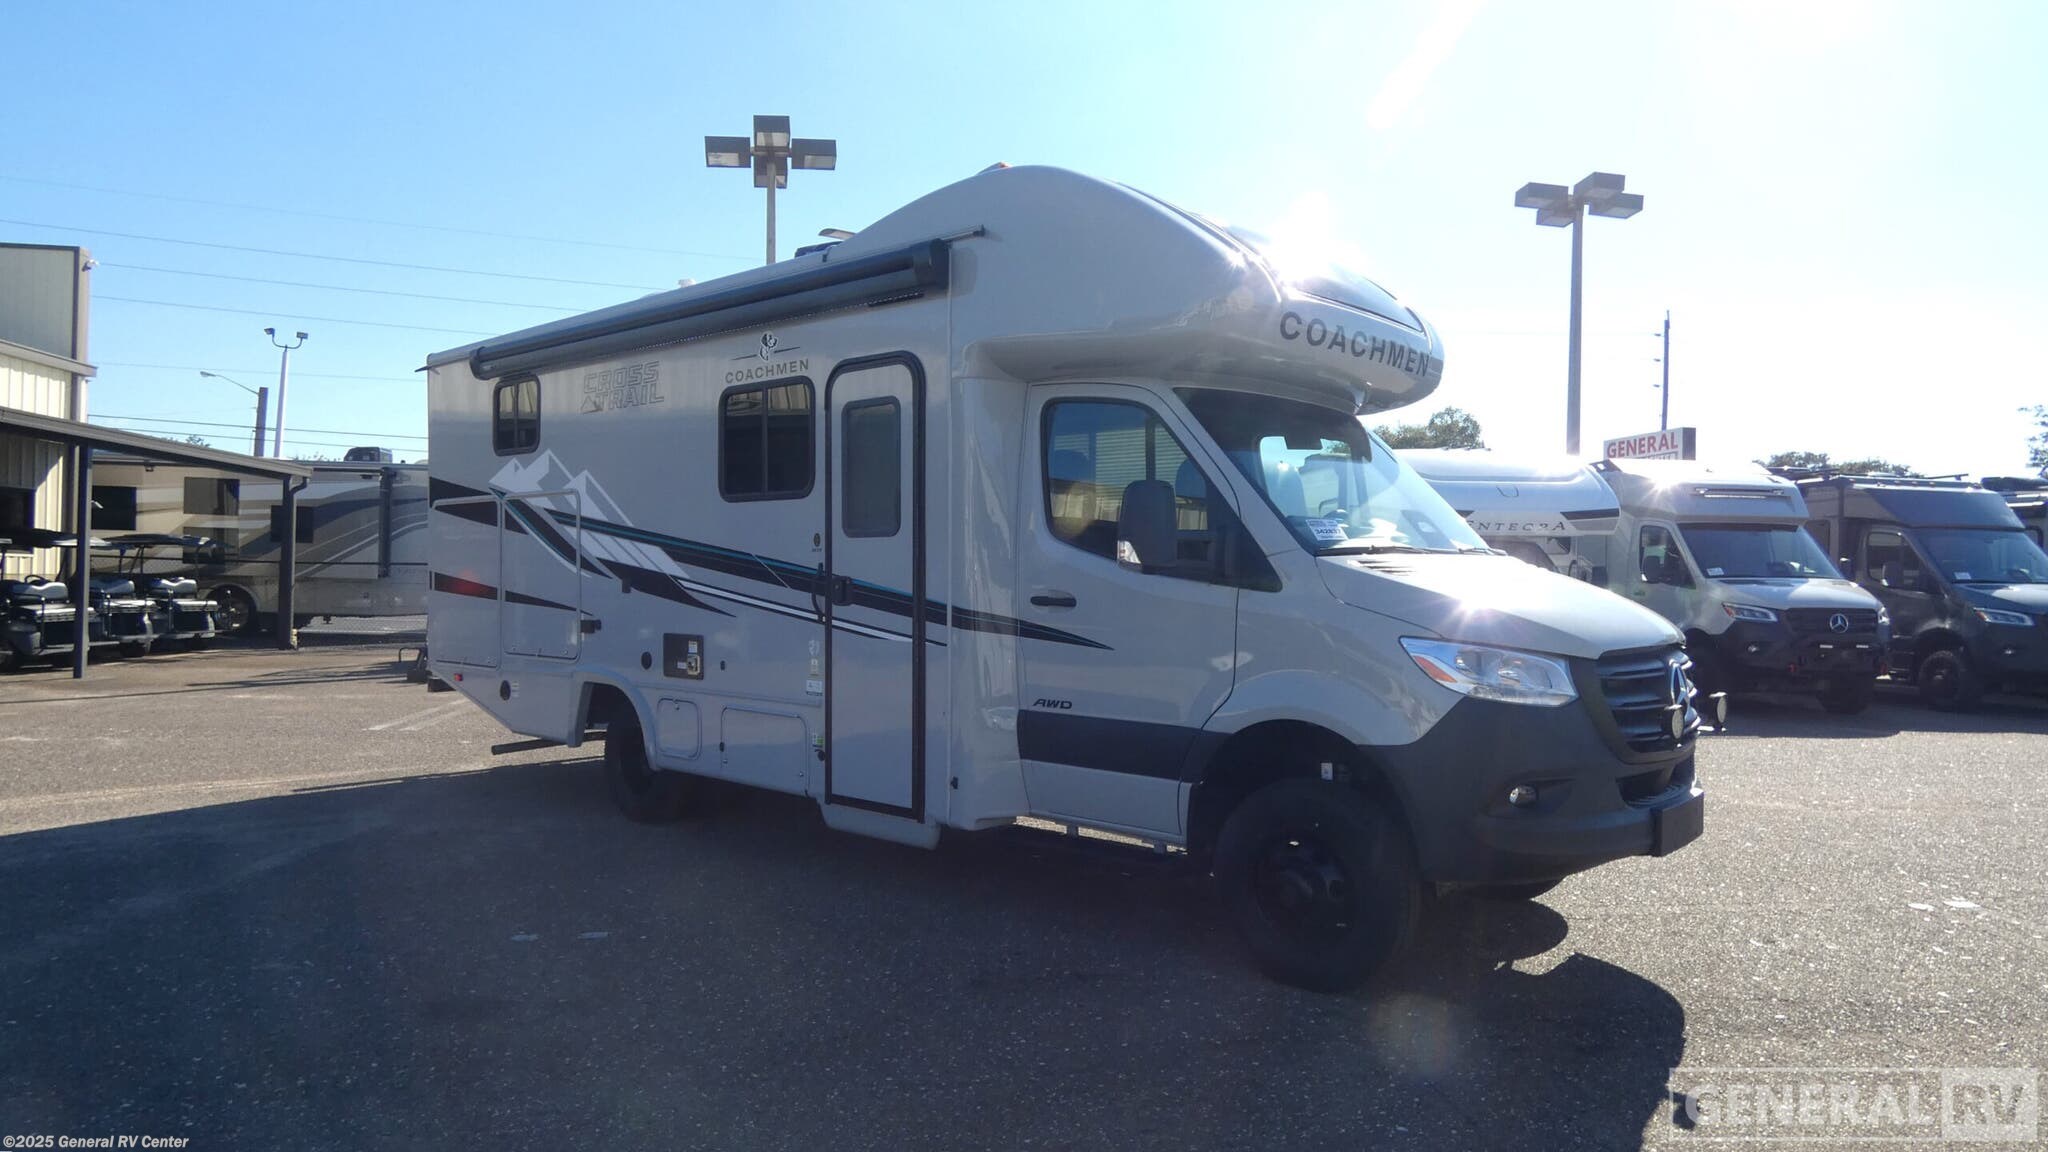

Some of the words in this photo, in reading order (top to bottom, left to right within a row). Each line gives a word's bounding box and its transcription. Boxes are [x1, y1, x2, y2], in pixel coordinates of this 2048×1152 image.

[1280, 311, 1430, 377] COACHMEN
[583, 361, 660, 394] CROSS
[725, 358, 809, 384] COACHMEN
[595, 383, 665, 411] TRAIL
[1607, 432, 1678, 458] GENERAL
[1032, 698, 1073, 710] AWD
